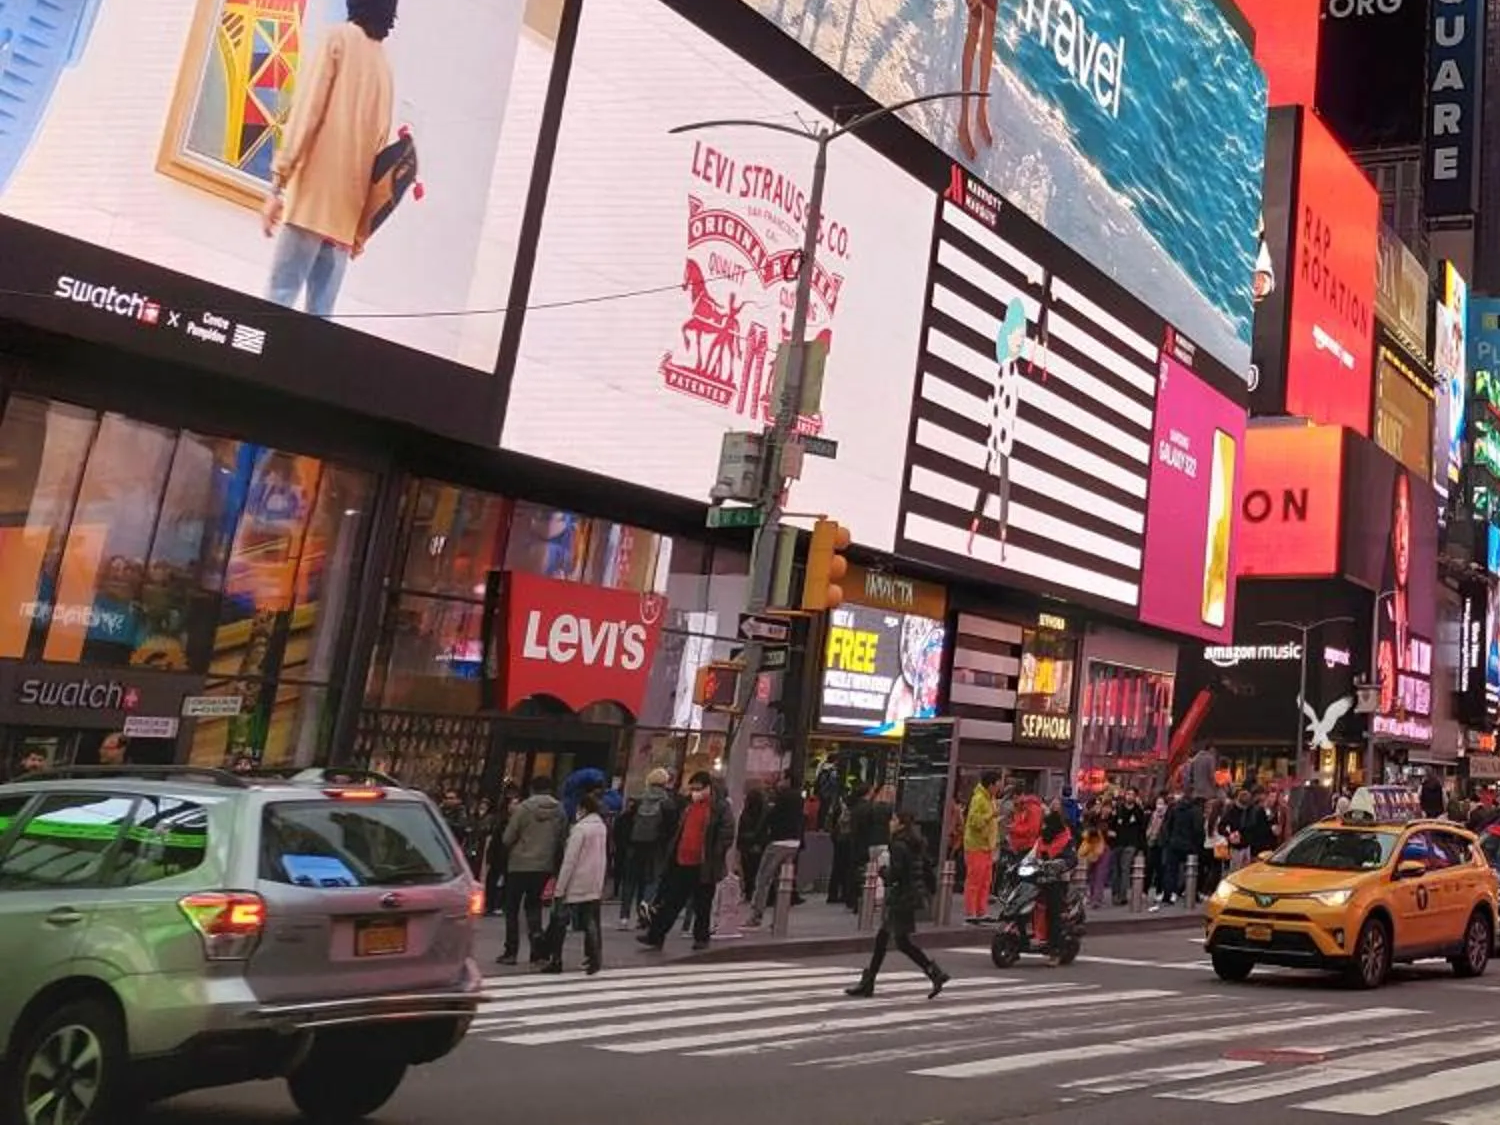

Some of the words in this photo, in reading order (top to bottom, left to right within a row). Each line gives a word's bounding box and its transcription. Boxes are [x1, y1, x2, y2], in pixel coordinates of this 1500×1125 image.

[691, 140, 736, 194] LEVI
[827, 221, 851, 261] CO.
[1304, 205, 1332, 259] RAP
[55, 275, 146, 320] swatch
[1301, 246, 1368, 338] ROTATION
[1242, 487, 1309, 525] ON
[864, 572, 914, 606] INVICTA
[826, 626, 880, 674] FREE
[1203, 644, 1257, 666] amazon
[1257, 641, 1303, 660] music
[20, 678, 123, 709] swatch
[1021, 713, 1072, 740] SEPHORA
